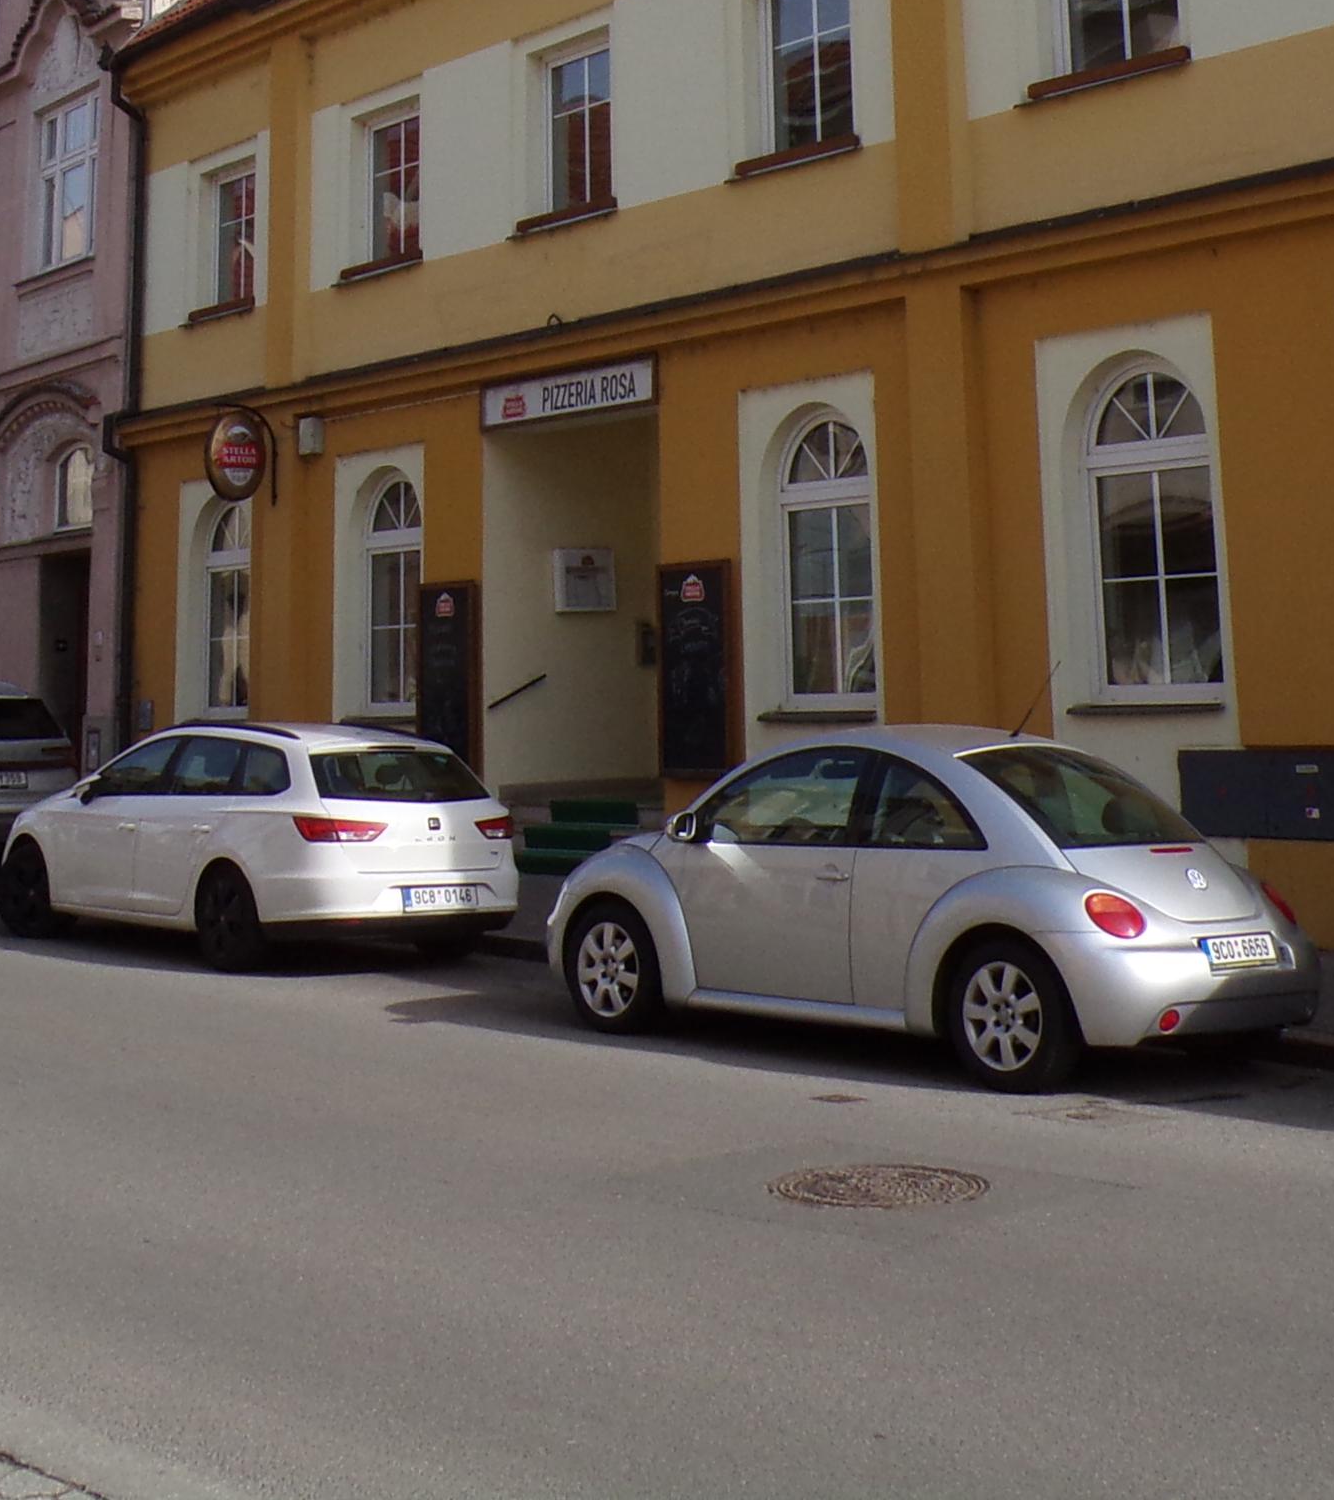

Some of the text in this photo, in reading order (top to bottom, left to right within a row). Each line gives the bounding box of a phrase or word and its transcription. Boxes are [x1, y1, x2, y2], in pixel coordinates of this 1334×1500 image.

[542, 379, 596, 412] PIZZERIA
[601, 371, 637, 402] ROSA
[1241, 938, 1270, 957] 6659
